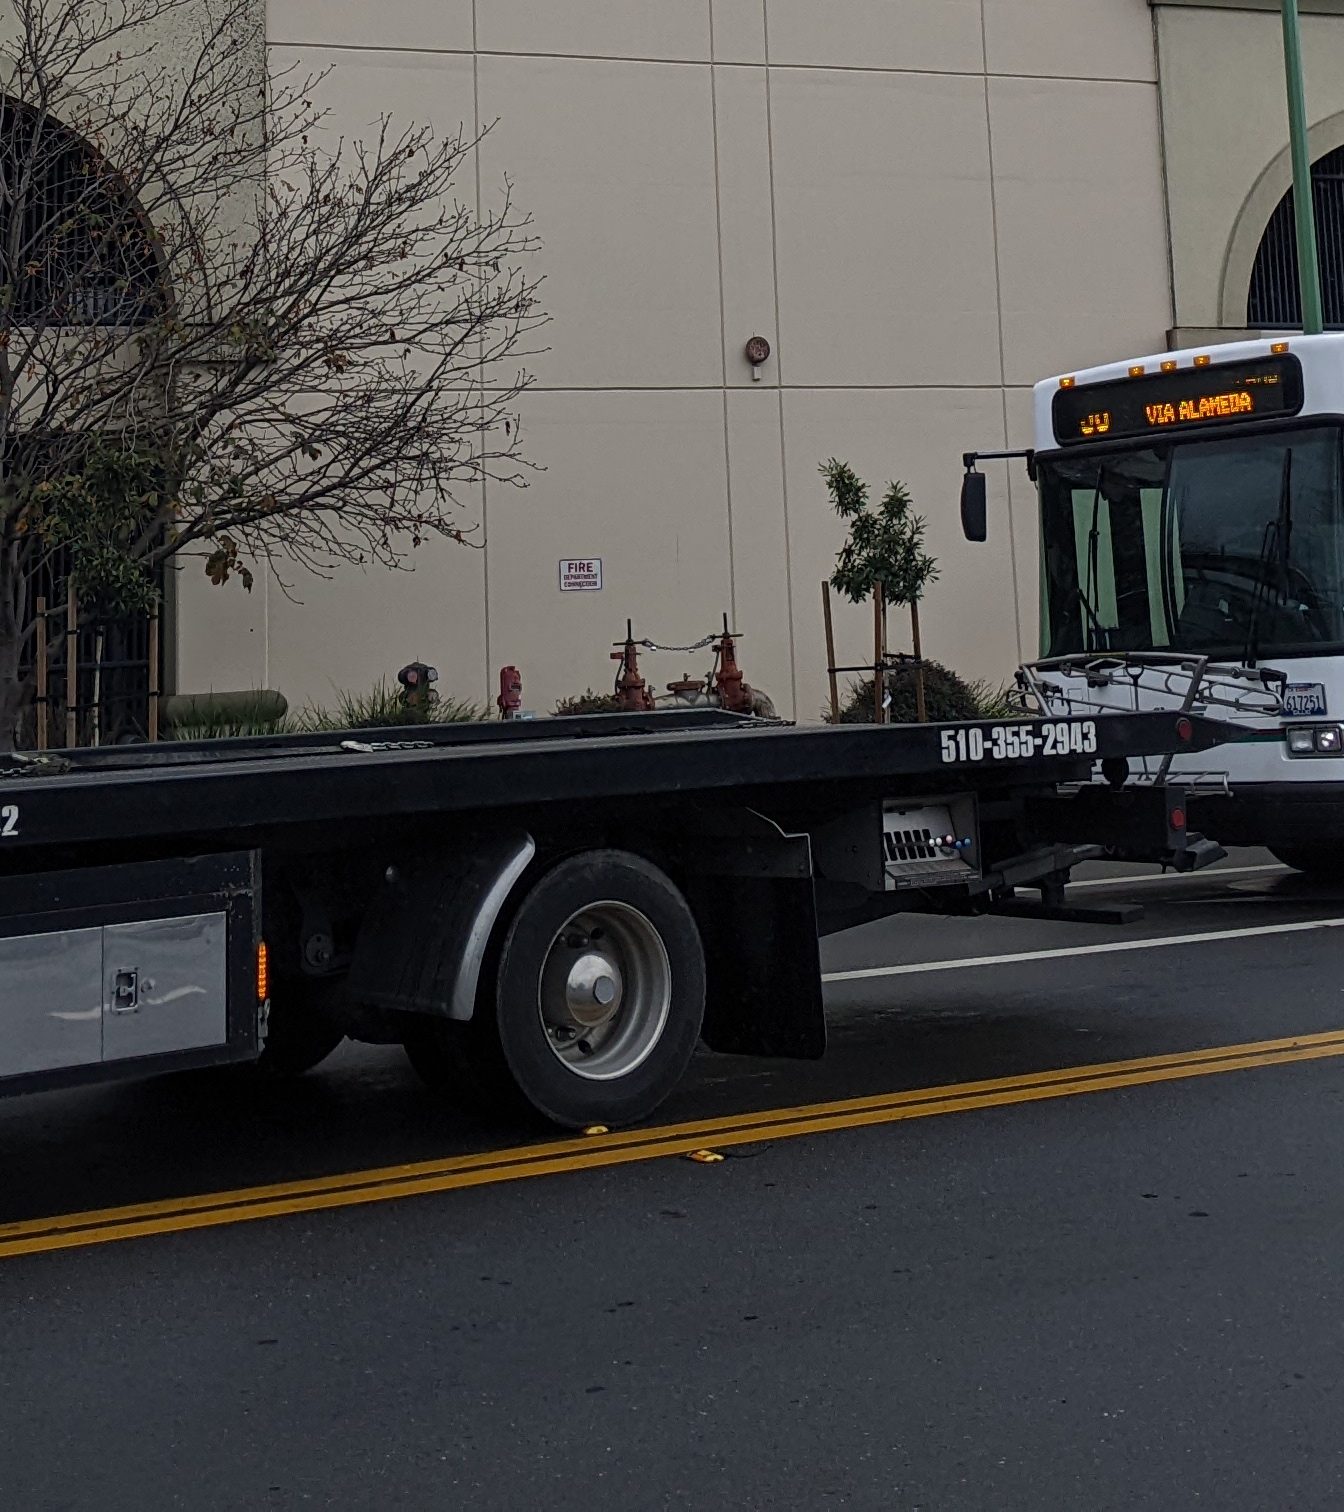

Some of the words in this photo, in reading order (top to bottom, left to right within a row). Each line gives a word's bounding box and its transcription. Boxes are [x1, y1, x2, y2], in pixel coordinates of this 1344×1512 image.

[1145, 403, 1175, 425] VIA
[1179, 391, 1253, 420] ALAMEDA
[567, 562, 594, 574] FIRE
[1286, 694, 1321, 711] 617251
[940, 720, 1098, 763] 510-355-2943
